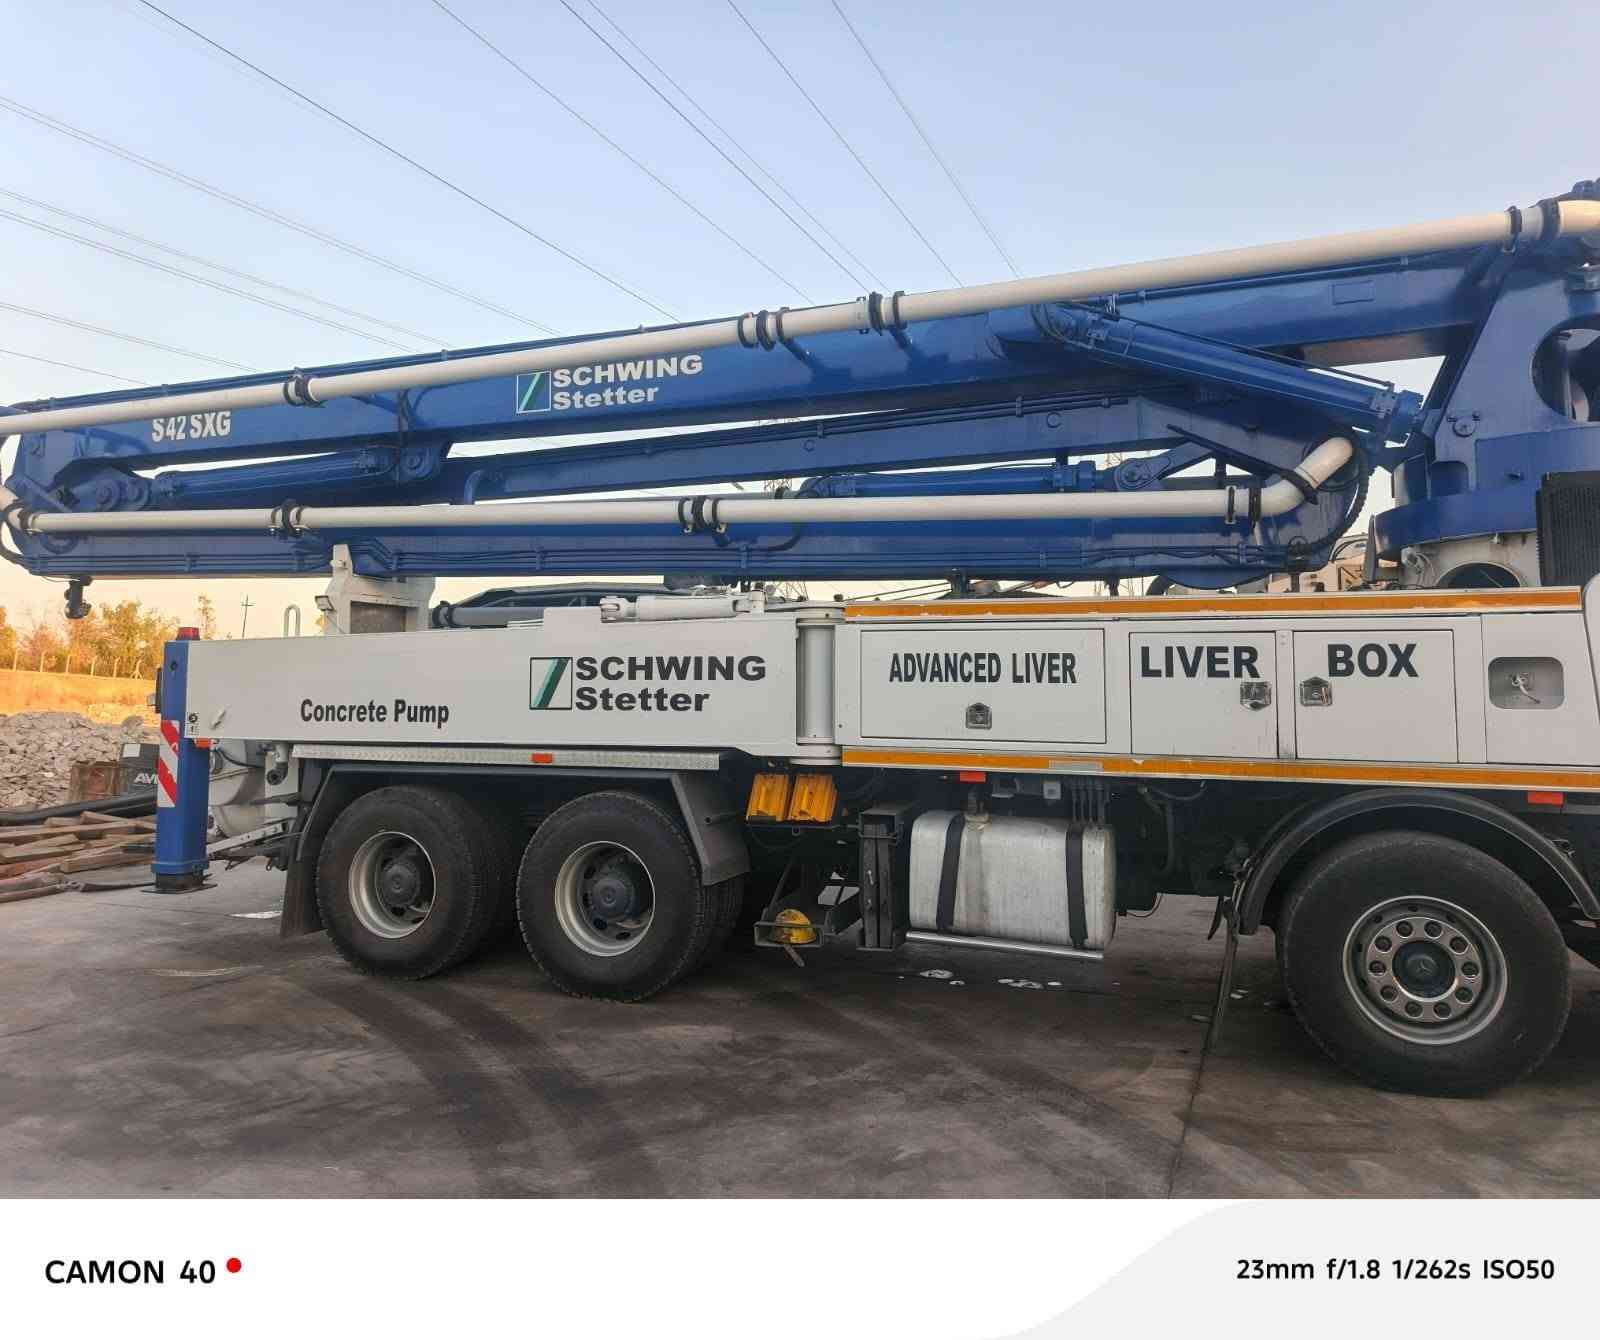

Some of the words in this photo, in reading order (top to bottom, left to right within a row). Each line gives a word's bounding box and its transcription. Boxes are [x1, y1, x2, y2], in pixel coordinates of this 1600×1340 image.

[553, 354, 703, 388] SCHWING
[553, 386, 659, 410] Stetter
[151, 415, 187, 443] S42
[189, 410, 231, 439] SXG
[575, 655, 766, 682] SCHWING
[889, 652, 1002, 683] ADVANCED
[1012, 652, 1077, 684] LIVER
[1140, 645, 1261, 679] LIVER
[1327, 643, 1419, 678] BOX
[300, 698, 388, 723] Concrete
[393, 699, 450, 729] Pump
[575, 686, 710, 712] Stetter
